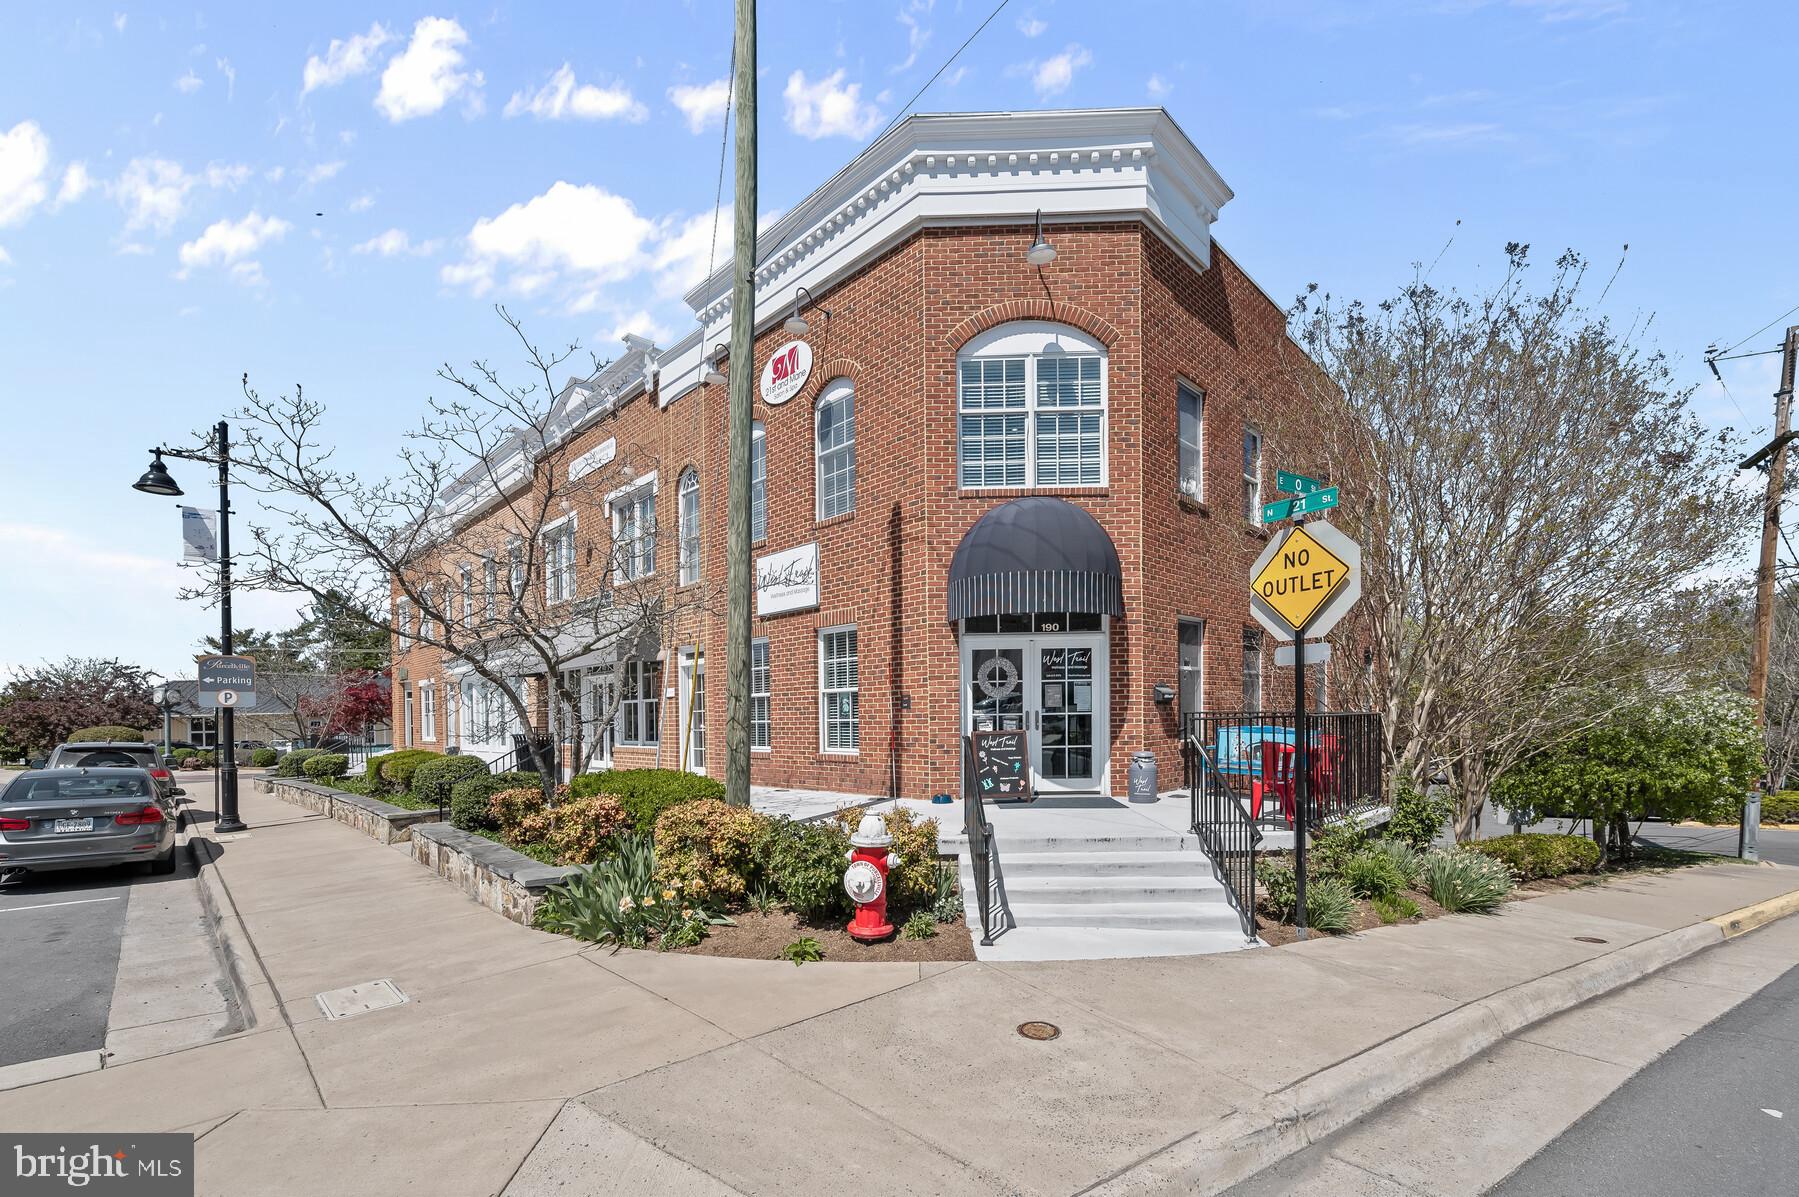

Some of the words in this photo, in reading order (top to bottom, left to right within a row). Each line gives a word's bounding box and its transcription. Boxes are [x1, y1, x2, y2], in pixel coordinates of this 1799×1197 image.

[765, 385, 776, 397] 21st
[777, 379, 788, 391] and
[789, 368, 807, 383] Mane
[1279, 476, 1284, 485] E
[1266, 508, 1273, 517] N
[1292, 499, 1306, 512] 21
[1284, 549, 1310, 570] NO
[1263, 569, 1335, 598] OUTLET
[1041, 623, 1060, 632] 190
[1042, 650, 1066, 666] West
[1067, 651, 1091, 666] Trail
[216, 676, 252, 686] Parking
[224, 692, 233, 704] P
[981, 735, 999, 748] West
[999, 735, 1018, 748] Trail
